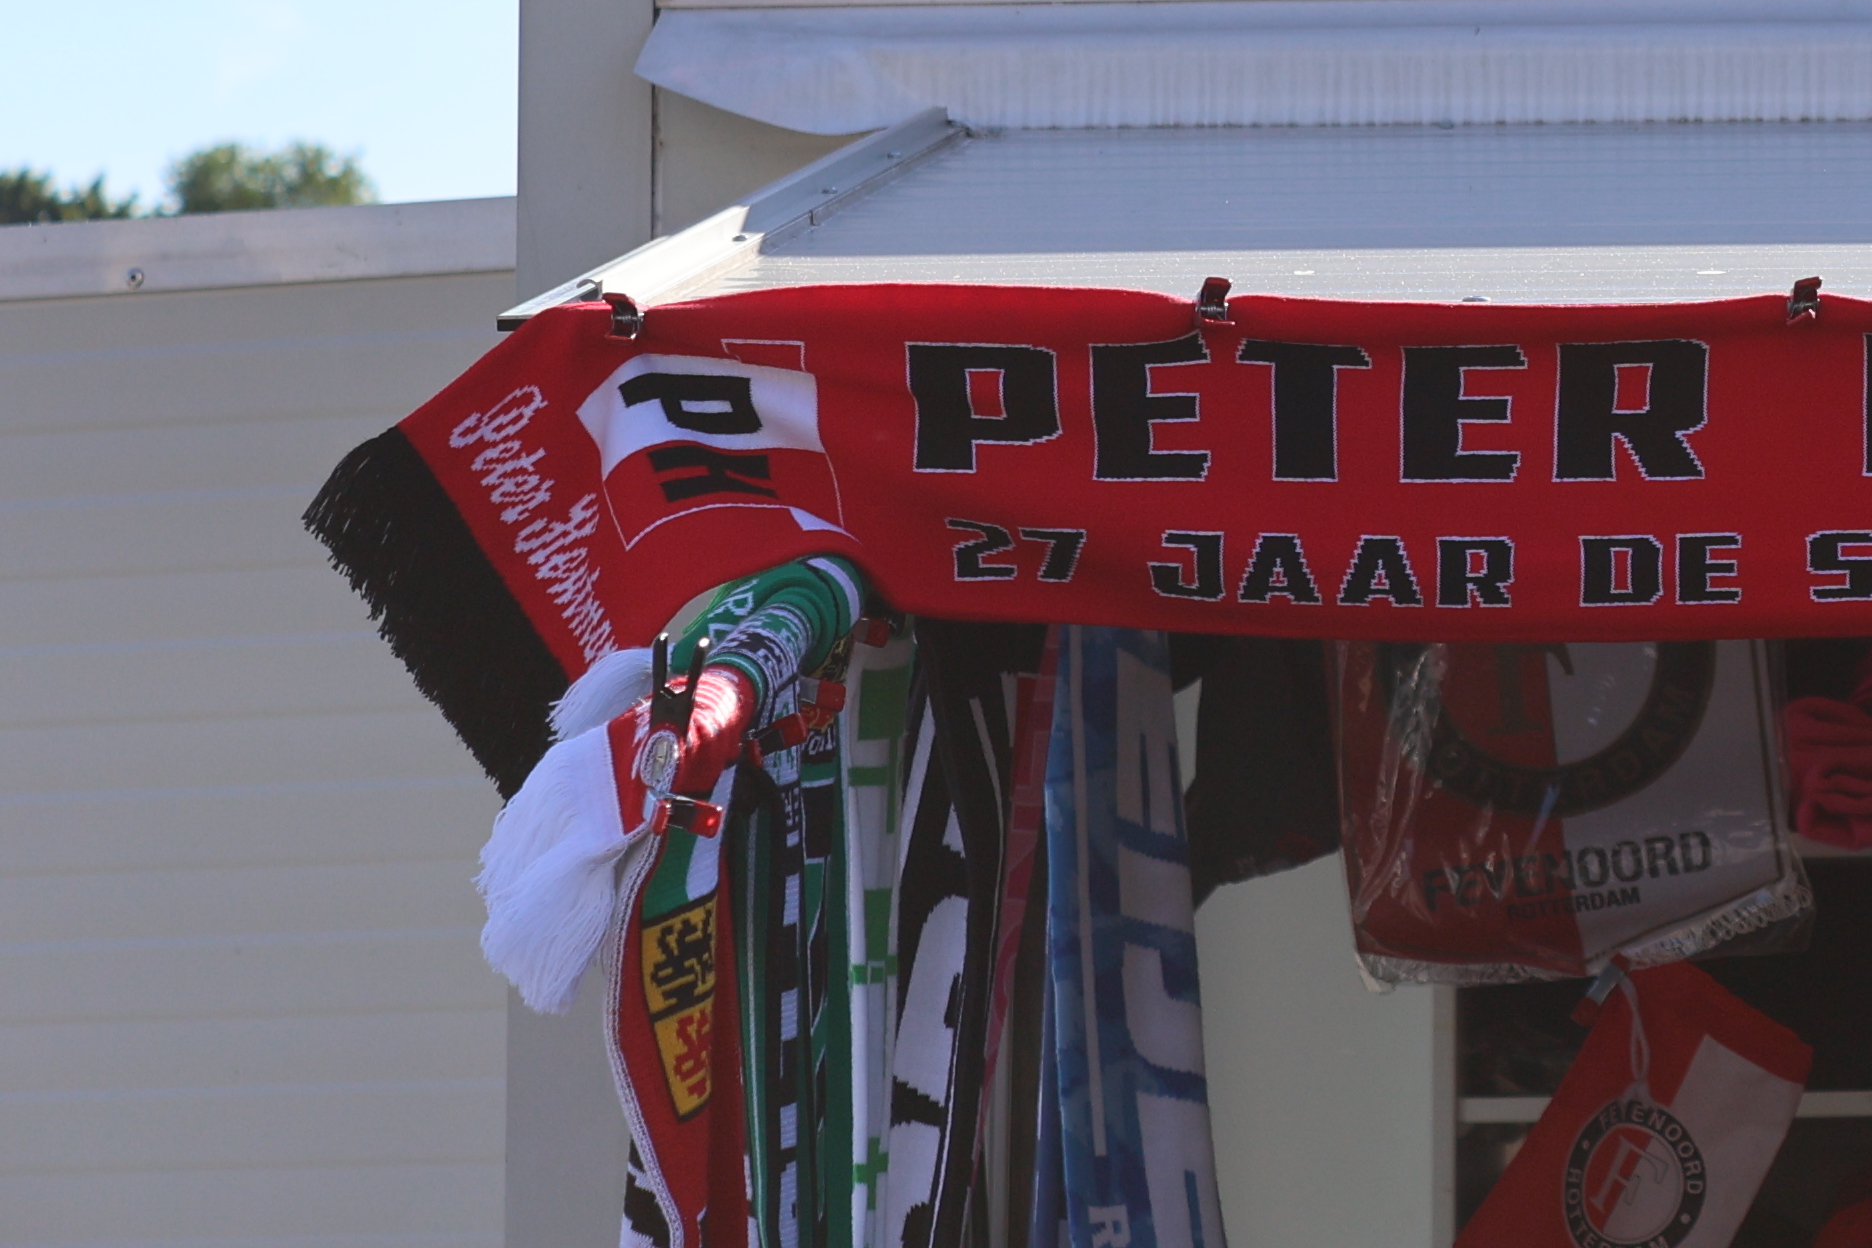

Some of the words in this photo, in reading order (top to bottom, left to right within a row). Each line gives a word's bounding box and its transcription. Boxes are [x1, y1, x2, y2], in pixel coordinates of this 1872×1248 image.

[905, 330, 1710, 483] PETER
[945, 517, 1086, 582] 27
[1147, 529, 1515, 608] JAAR
[1579, 532, 1743, 607] DE
[1506, 886, 1641, 922] ROTTERDAM
[1599, 1102, 1705, 1195] FEYENOORD
